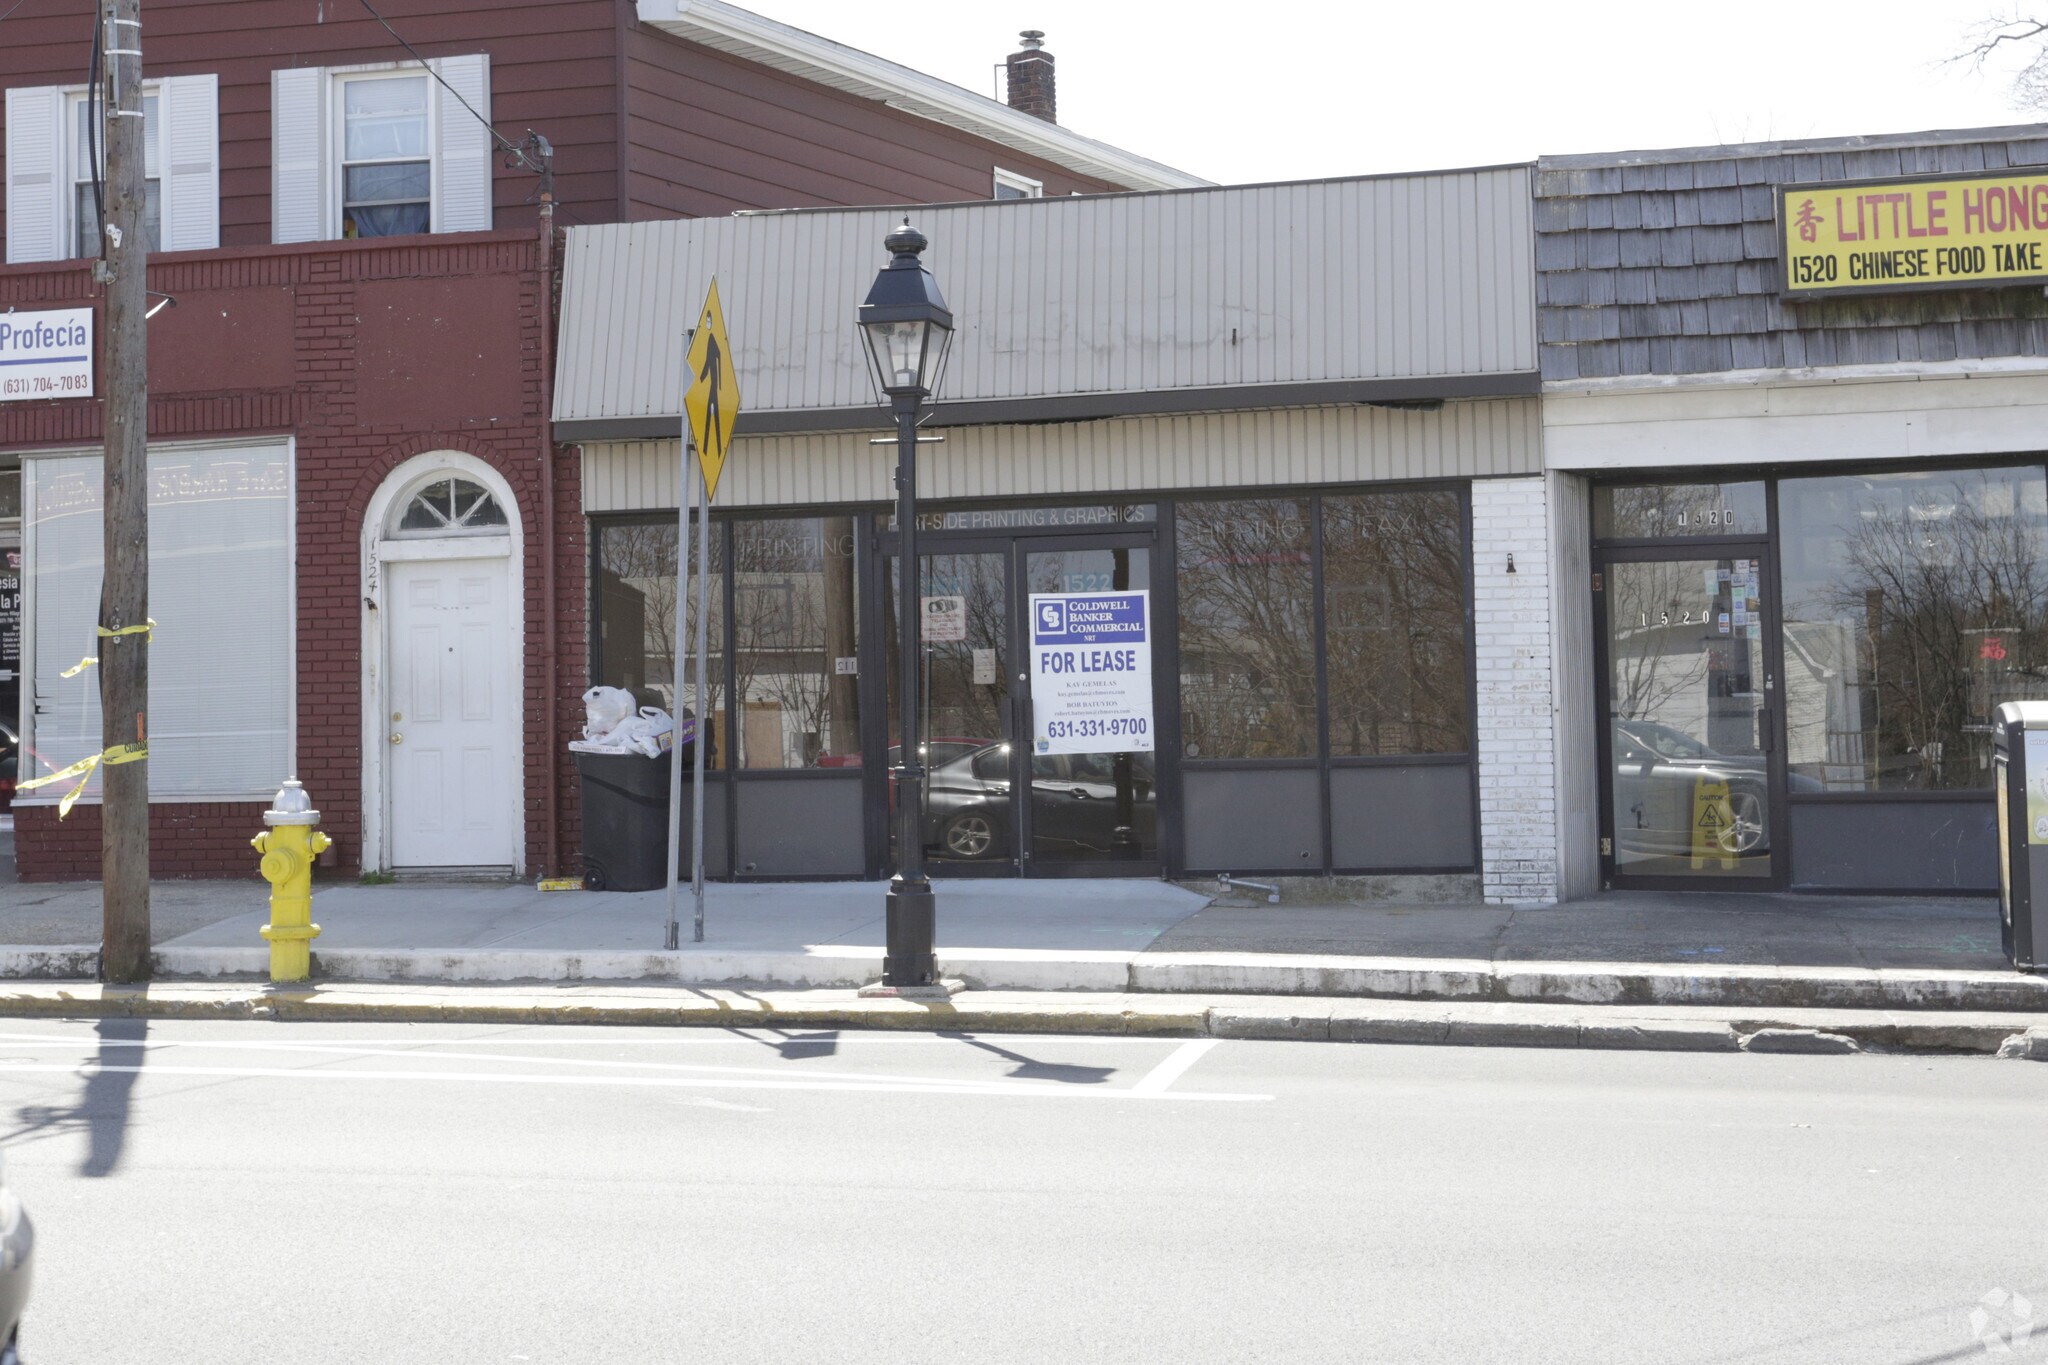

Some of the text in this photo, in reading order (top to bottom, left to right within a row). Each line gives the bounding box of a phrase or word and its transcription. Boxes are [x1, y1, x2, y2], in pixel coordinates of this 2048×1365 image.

[1793, 198, 1825, 244] 香
[1835, 190, 1949, 243] LITTLE
[1793, 242, 2043, 284] 1520 CHINESE FOOD TAKE
[0, 318, 86, 351] Profecía
[3, 374, 88, 396] (631) 704-7083
[972, 510, 1046, 528] PRINTING
[1048, 511, 1060, 526] &
[1063, 505, 1146, 525] GRAPHICS
[1, 593, 11, 609] la
[1069, 600, 1130, 612] COLDWELL
[1069, 612, 1114, 623] BANKER
[1069, 622, 1144, 634] COMMERCIAL
[1640, 609, 1711, 627] 1520
[1041, 650, 1136, 674] FOR LEASE
[1047, 717, 1147, 738] 631-331-9700
